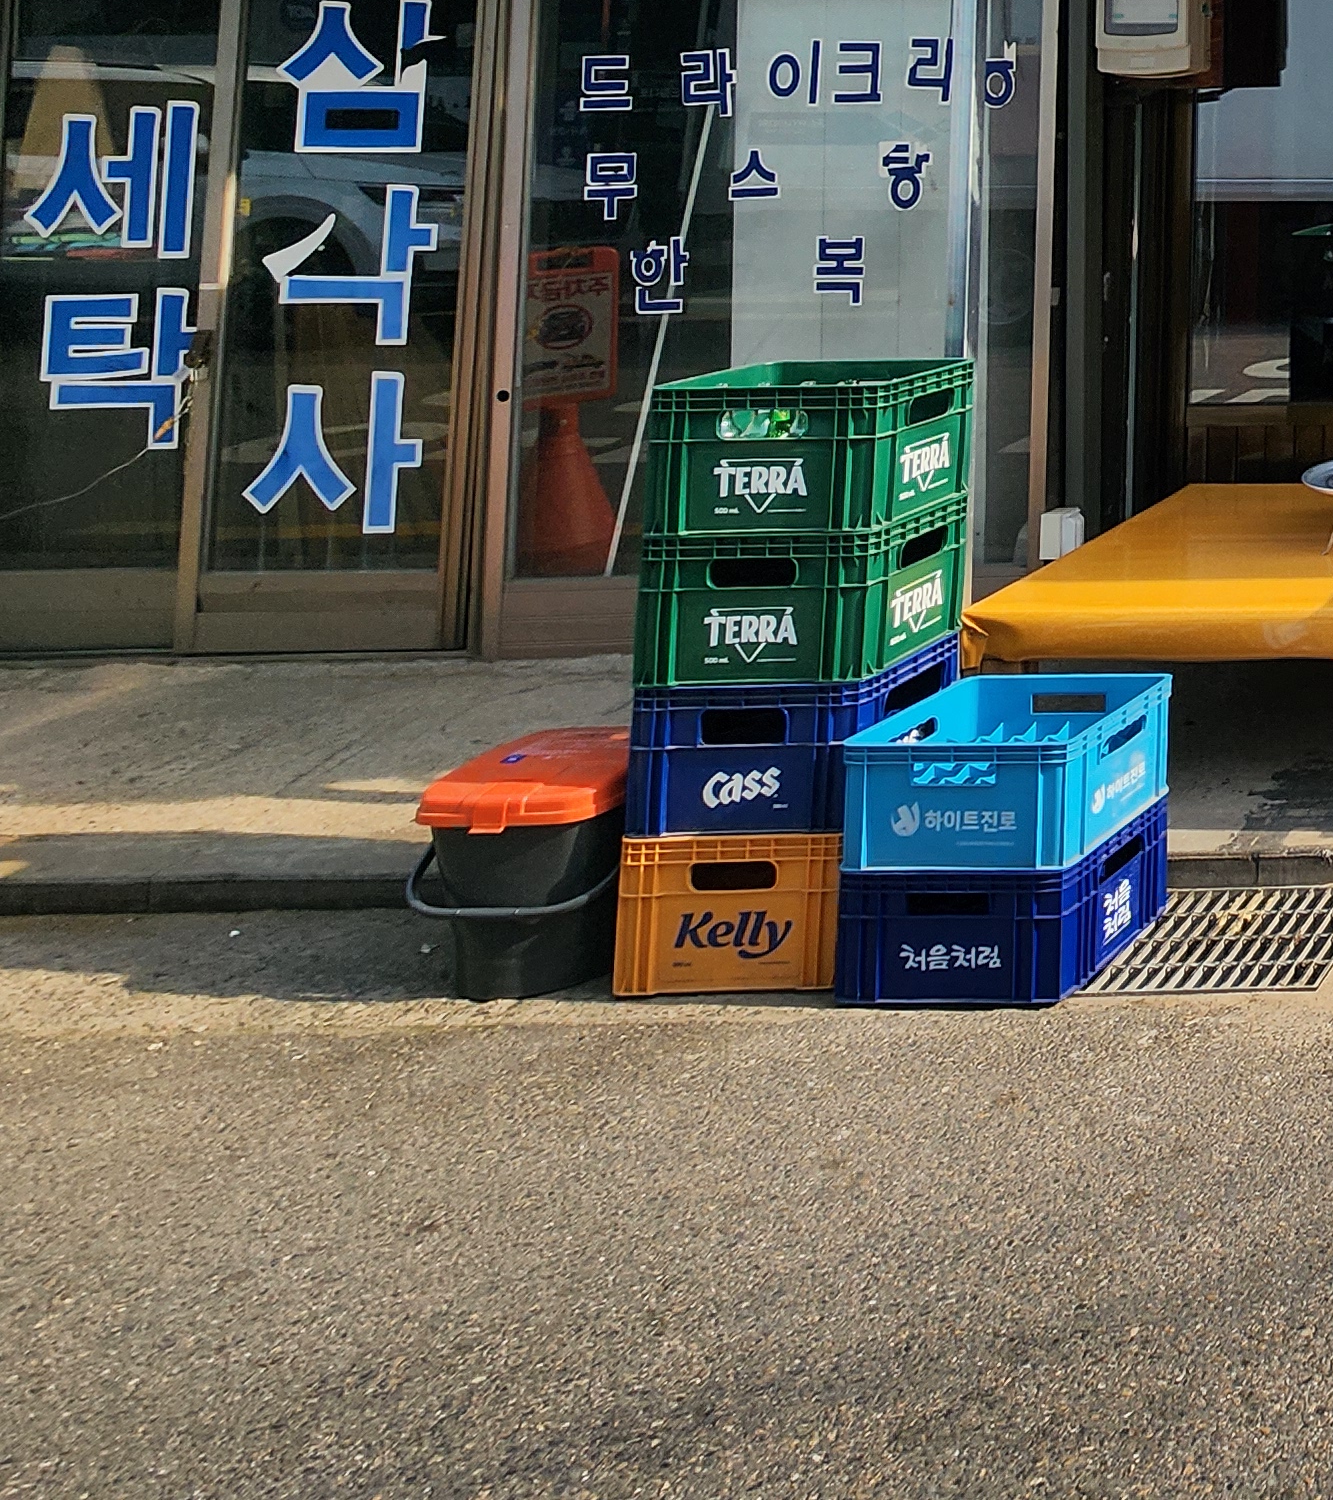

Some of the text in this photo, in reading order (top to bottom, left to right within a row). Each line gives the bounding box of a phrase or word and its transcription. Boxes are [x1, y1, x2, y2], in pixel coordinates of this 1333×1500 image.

[22, 98, 202, 450] 세탁
[630, 234, 866, 315] 한복
[713, 462, 808, 498] TERRA
[899, 436, 951, 485] TERRA
[890, 576, 944, 629] TERRA
[703, 611, 798, 648] TERRA
[1106, 760, 1146, 800] 하이트진로
[924, 808, 1017, 833] 하이트진로
[674, 910, 793, 959] Kelly
[899, 943, 1002, 972] 처음처럼
